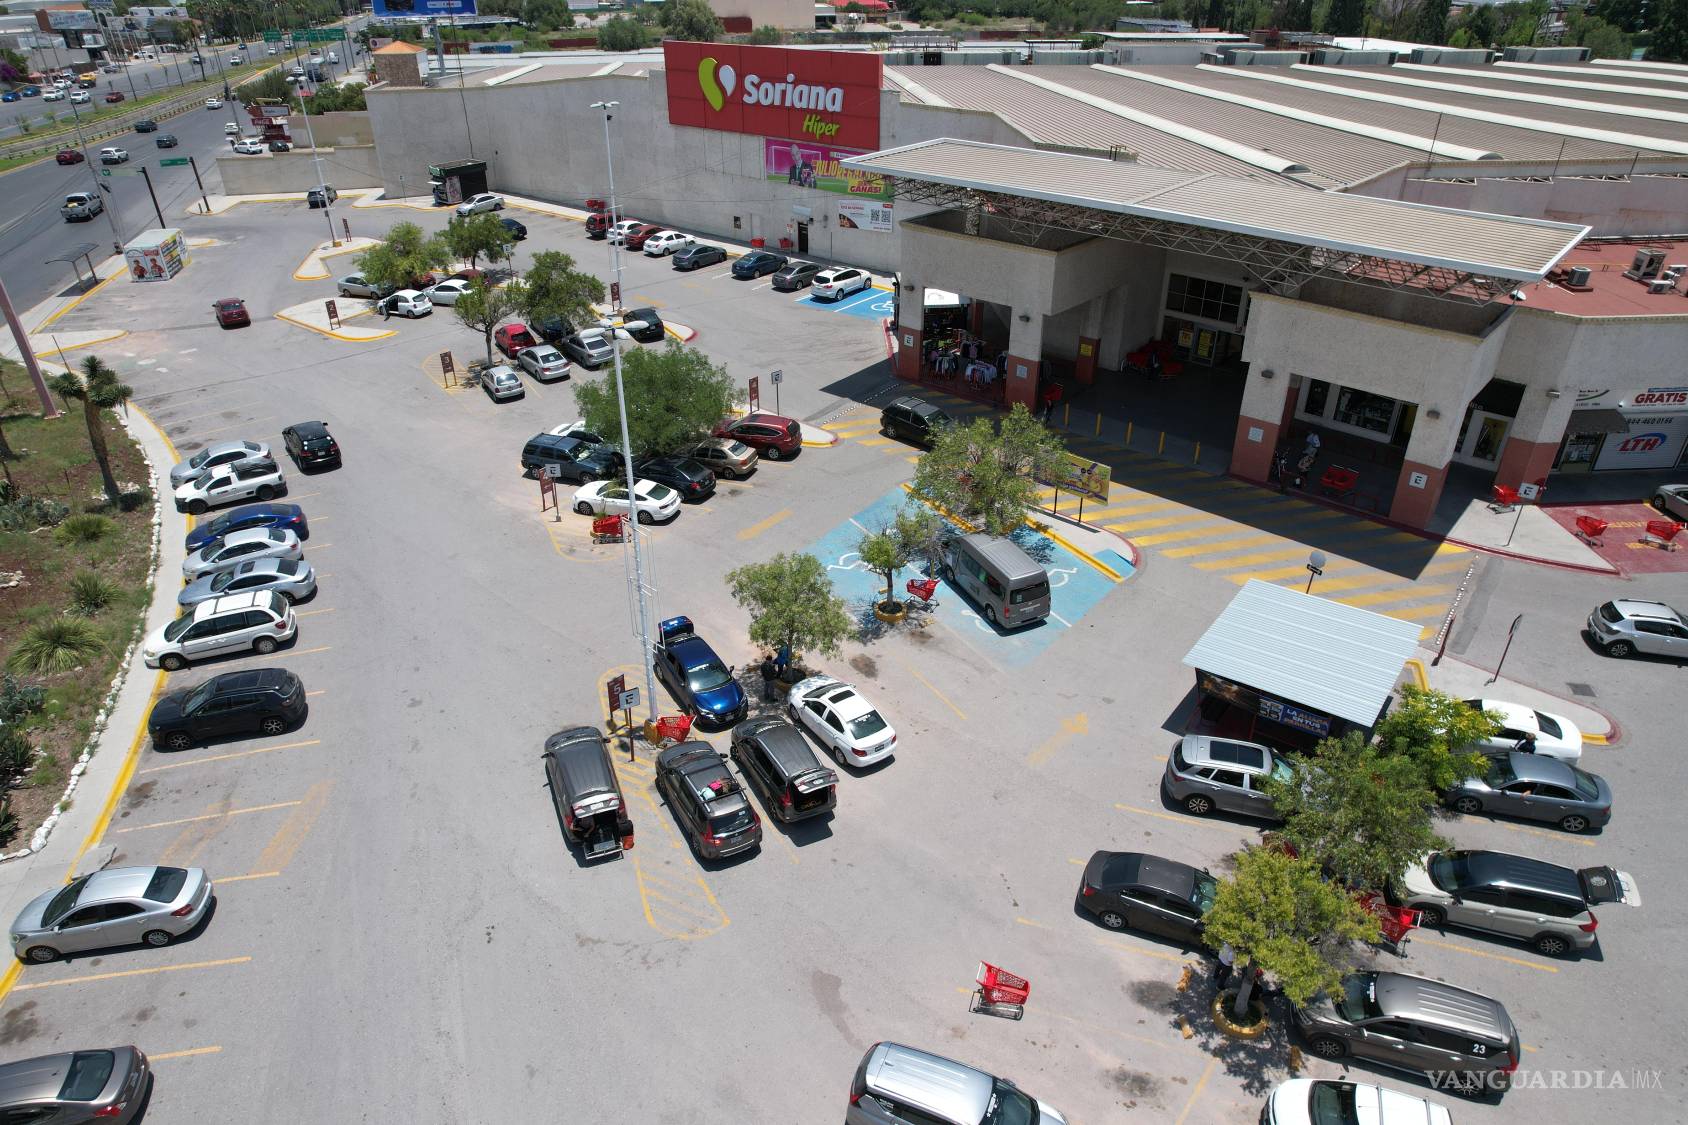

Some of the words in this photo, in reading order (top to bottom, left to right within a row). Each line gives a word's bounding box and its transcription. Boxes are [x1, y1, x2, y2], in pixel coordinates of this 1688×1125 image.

[743, 73, 844, 113] Soriana
[1635, 392, 1688, 404] GRATIS
[1618, 438, 1660, 451] LTH
[1472, 1043, 1487, 1055] 23
